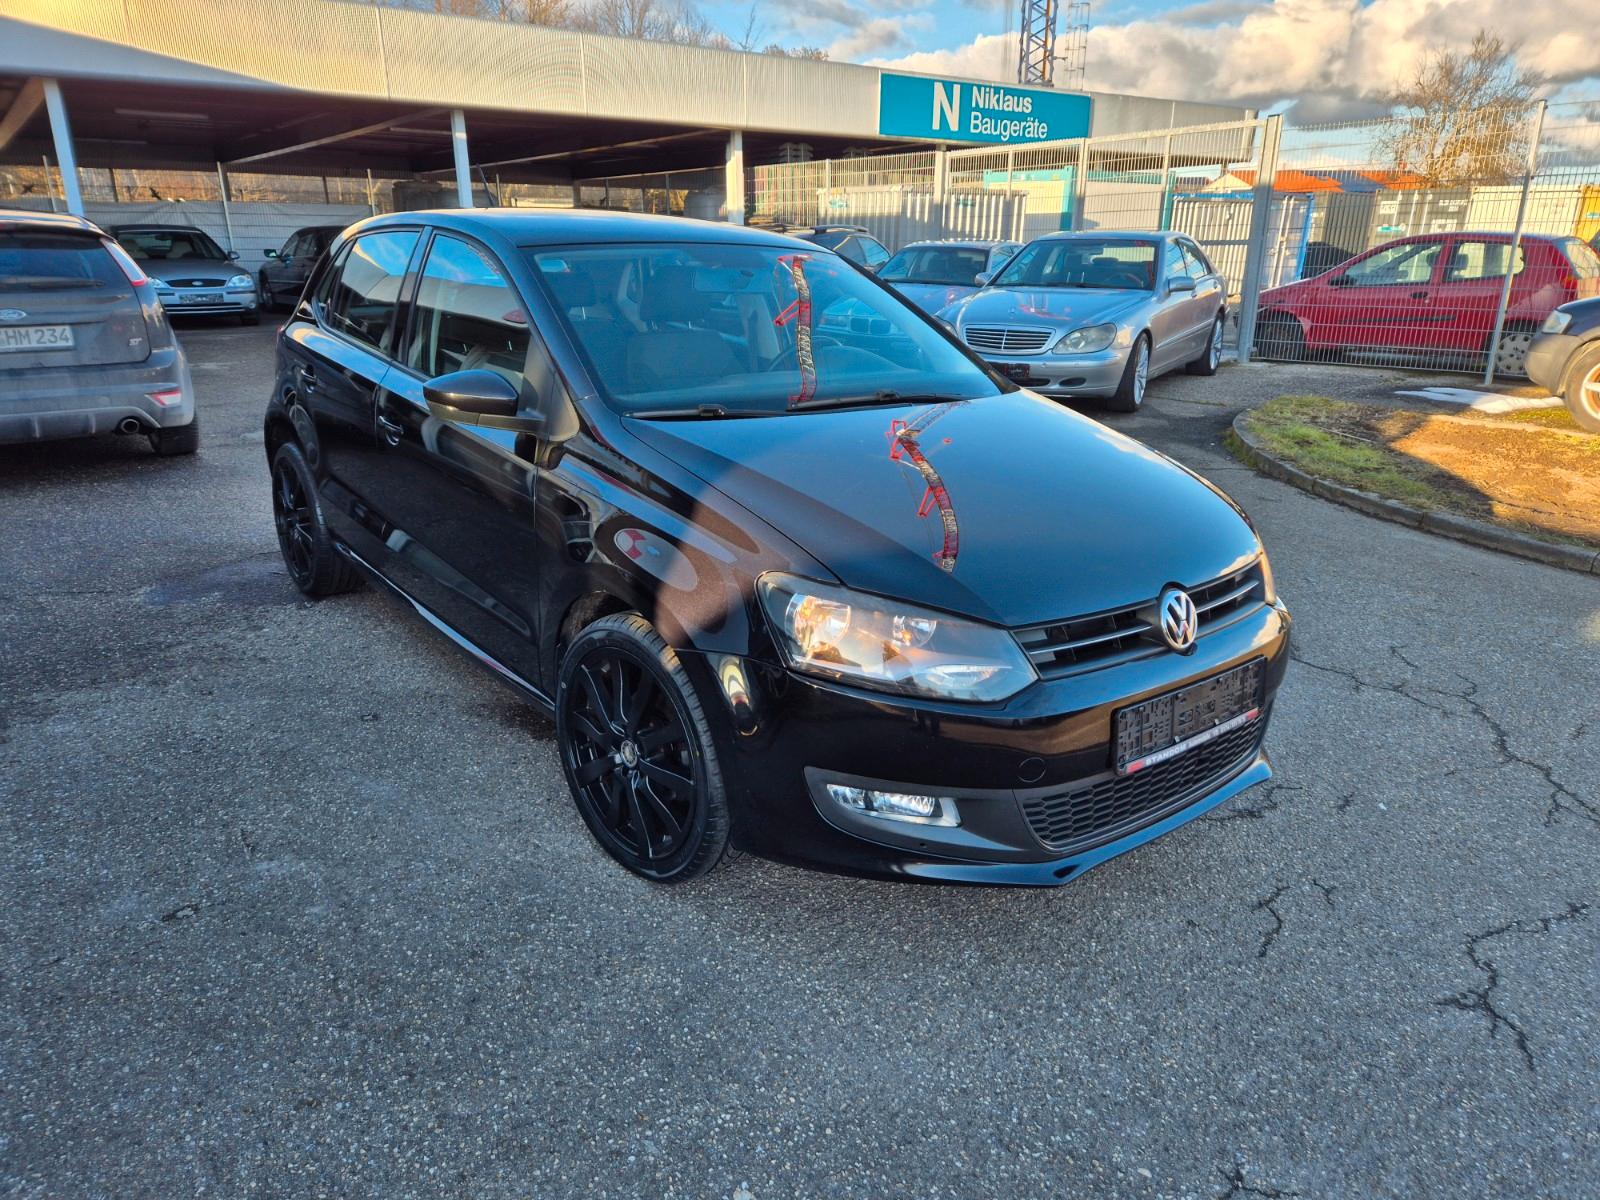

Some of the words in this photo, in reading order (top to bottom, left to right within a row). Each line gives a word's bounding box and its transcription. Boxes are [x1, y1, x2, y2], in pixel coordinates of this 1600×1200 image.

[932, 82, 961, 131] N
[972, 86, 1032, 113] Niklaus
[970, 112, 1047, 141] Baugeräte
[34, 328, 70, 344] 234
